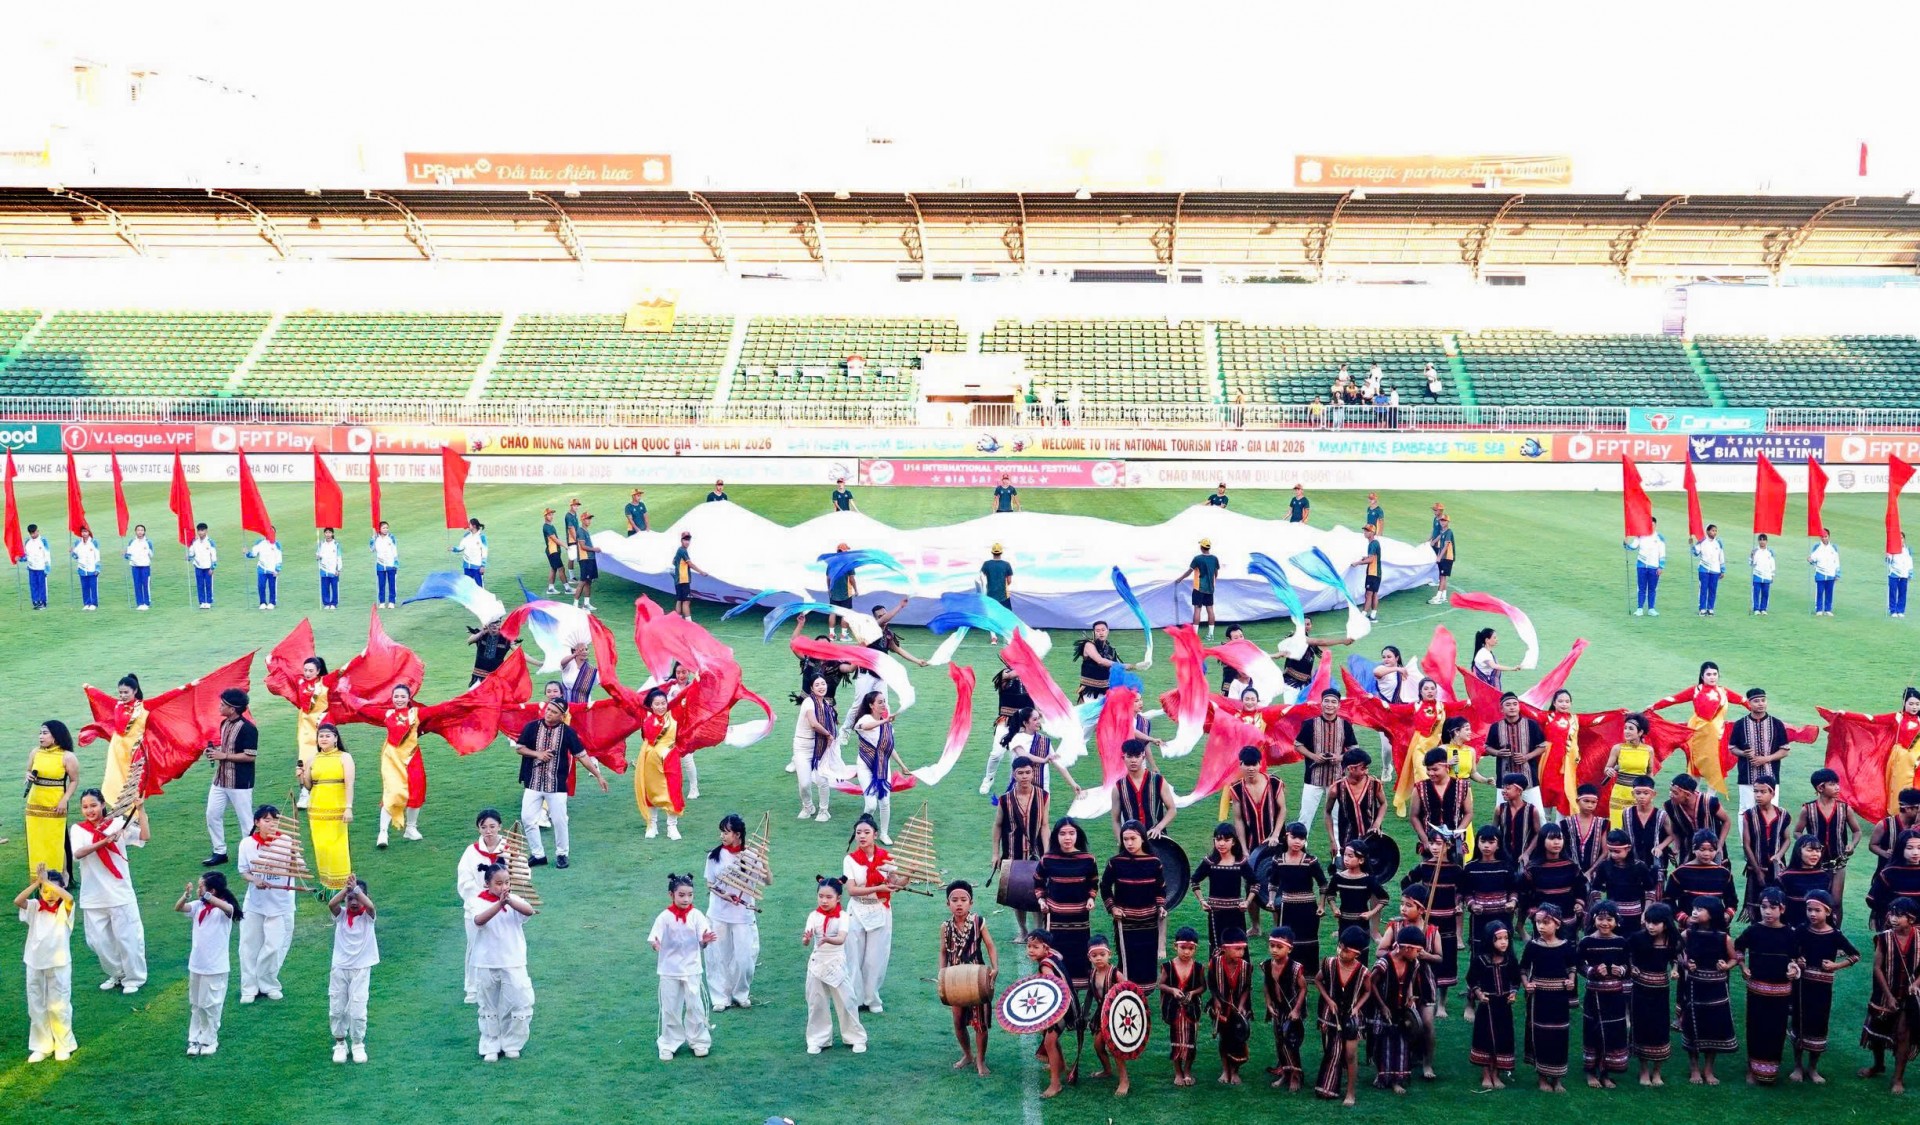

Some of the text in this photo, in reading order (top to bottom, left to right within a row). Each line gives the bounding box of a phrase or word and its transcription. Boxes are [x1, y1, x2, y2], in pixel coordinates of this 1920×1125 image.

[1330, 164, 1400, 182] Strategic
[239, 431, 315, 451] FPT Play
[595, 437, 609, 450] DU
[674, 437, 691, 450] GIA
[702, 437, 720, 450] GIA
[724, 437, 740, 450] LAI
[745, 437, 772, 450] 2026
[1041, 438, 1085, 451] WELCOME
[1090, 438, 1100, 451] TO
[1104, 438, 1119, 451] THE
[1124, 439, 1167, 452] NATIONAL
[1171, 439, 1211, 452] TOURISM
[1215, 439, 1238, 452] YEAR
[1247, 439, 1262, 453] GIA
[1265, 439, 1279, 453] LAI
[1283, 439, 1305, 453] 2026
[1737, 437, 1811, 446] SAVABECO
[1597, 440, 1672, 460] FPT Play
[1714, 447, 1823, 459] BIA NGHE TINH
[1870, 441, 1904, 458] FPT
[140, 464, 161, 474] STATE
[282, 464, 294, 473] FC
[345, 464, 389, 476] WELCME
[395, 464, 406, 476] TO
[409, 464, 426, 477] THE
[477, 464, 517, 477] TOURISM
[520, 465, 544, 477] YEAR
[903, 464, 1083, 473] U14 INTERNATIONAL FOOTBALL FESTIVAL
